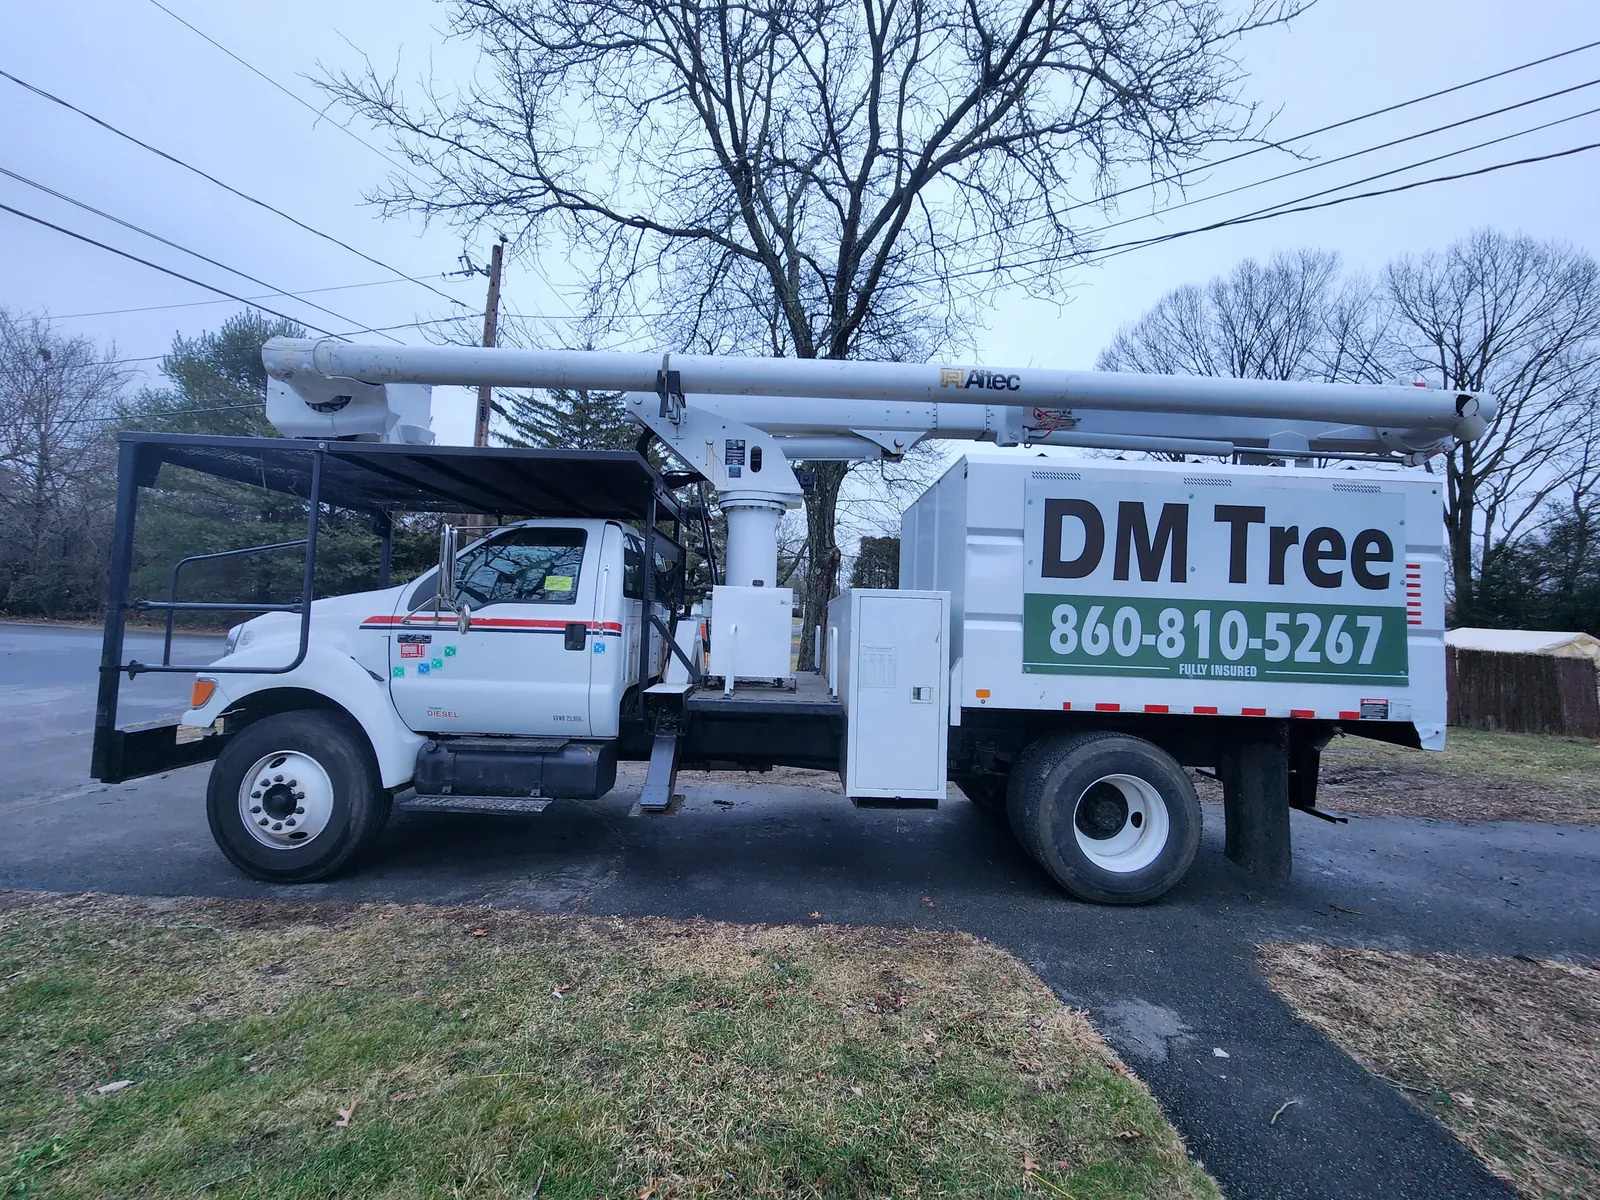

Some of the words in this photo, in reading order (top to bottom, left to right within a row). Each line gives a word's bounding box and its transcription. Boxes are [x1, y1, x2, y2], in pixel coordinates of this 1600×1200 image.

[1041, 498, 1189, 583] DM
[1214, 505, 1394, 590] Tree
[1049, 603, 1383, 665] 860-810-5267
[1179, 663, 1208, 676] FULLY
[1211, 664, 1258, 677] INSURED
[427, 710, 459, 718] DIESEL
